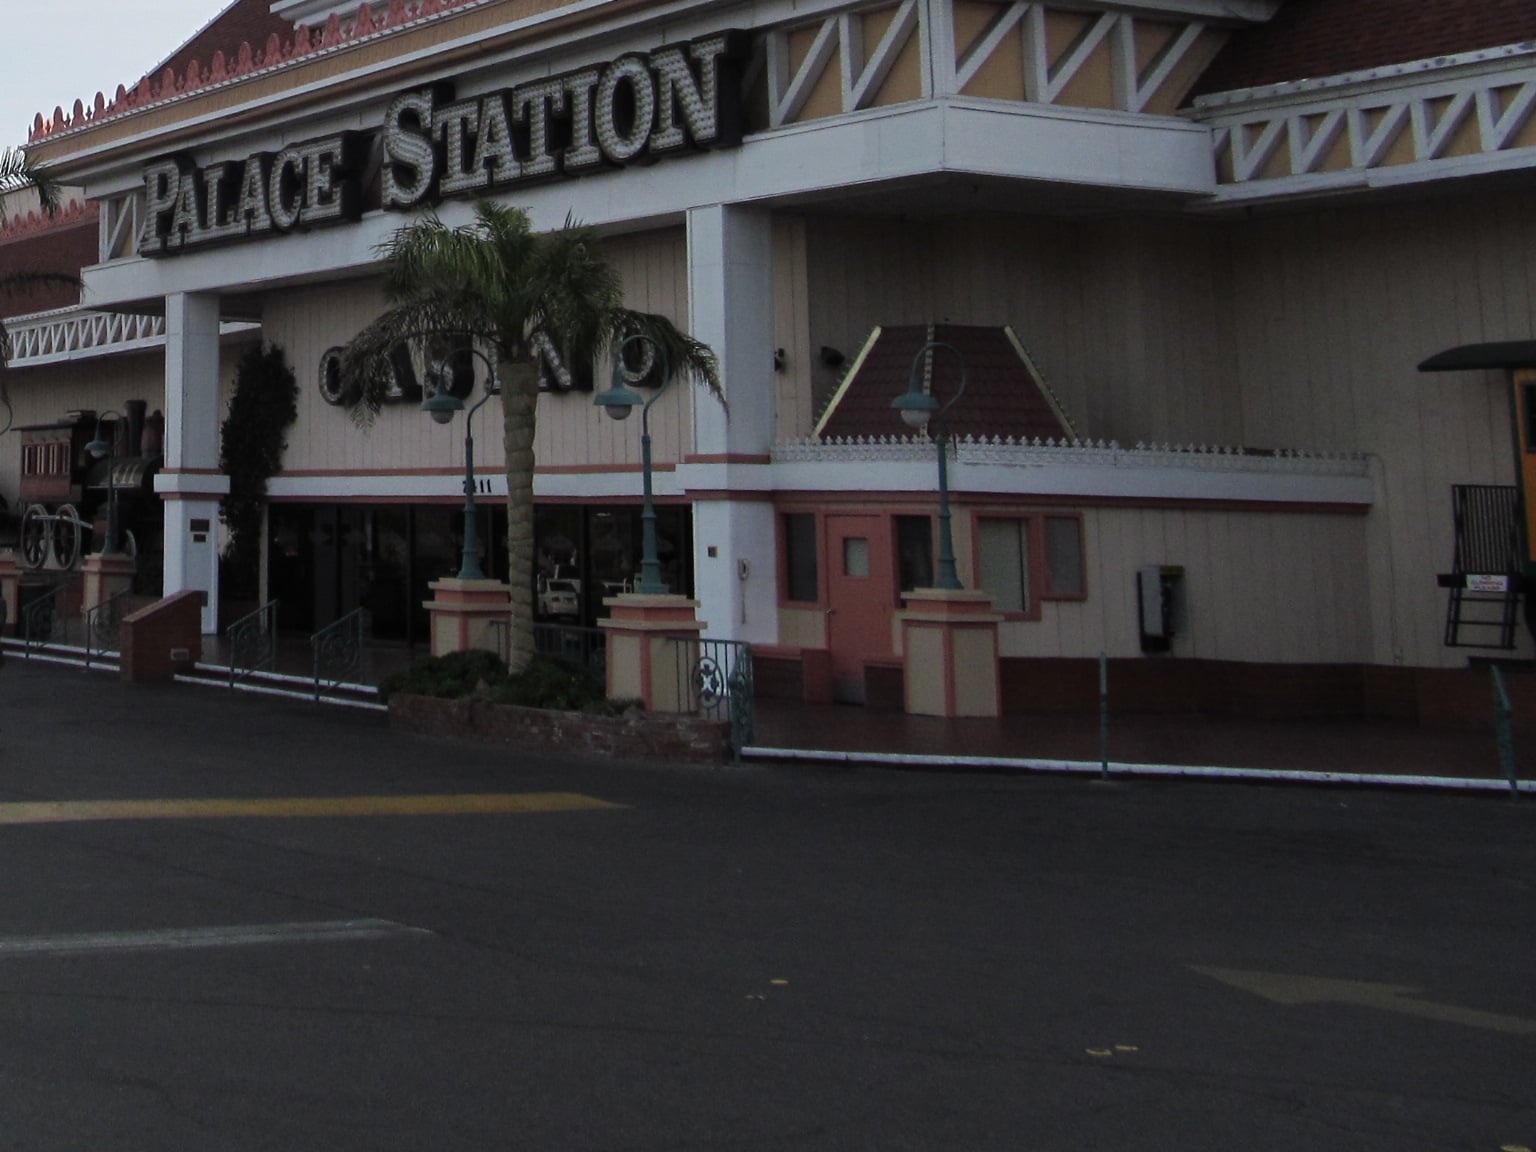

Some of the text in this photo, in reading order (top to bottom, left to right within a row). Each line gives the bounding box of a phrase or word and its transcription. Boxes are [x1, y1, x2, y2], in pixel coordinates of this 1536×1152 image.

[140, 38, 725, 256] PALACE STATION
[319, 332, 657, 405] CSNO
